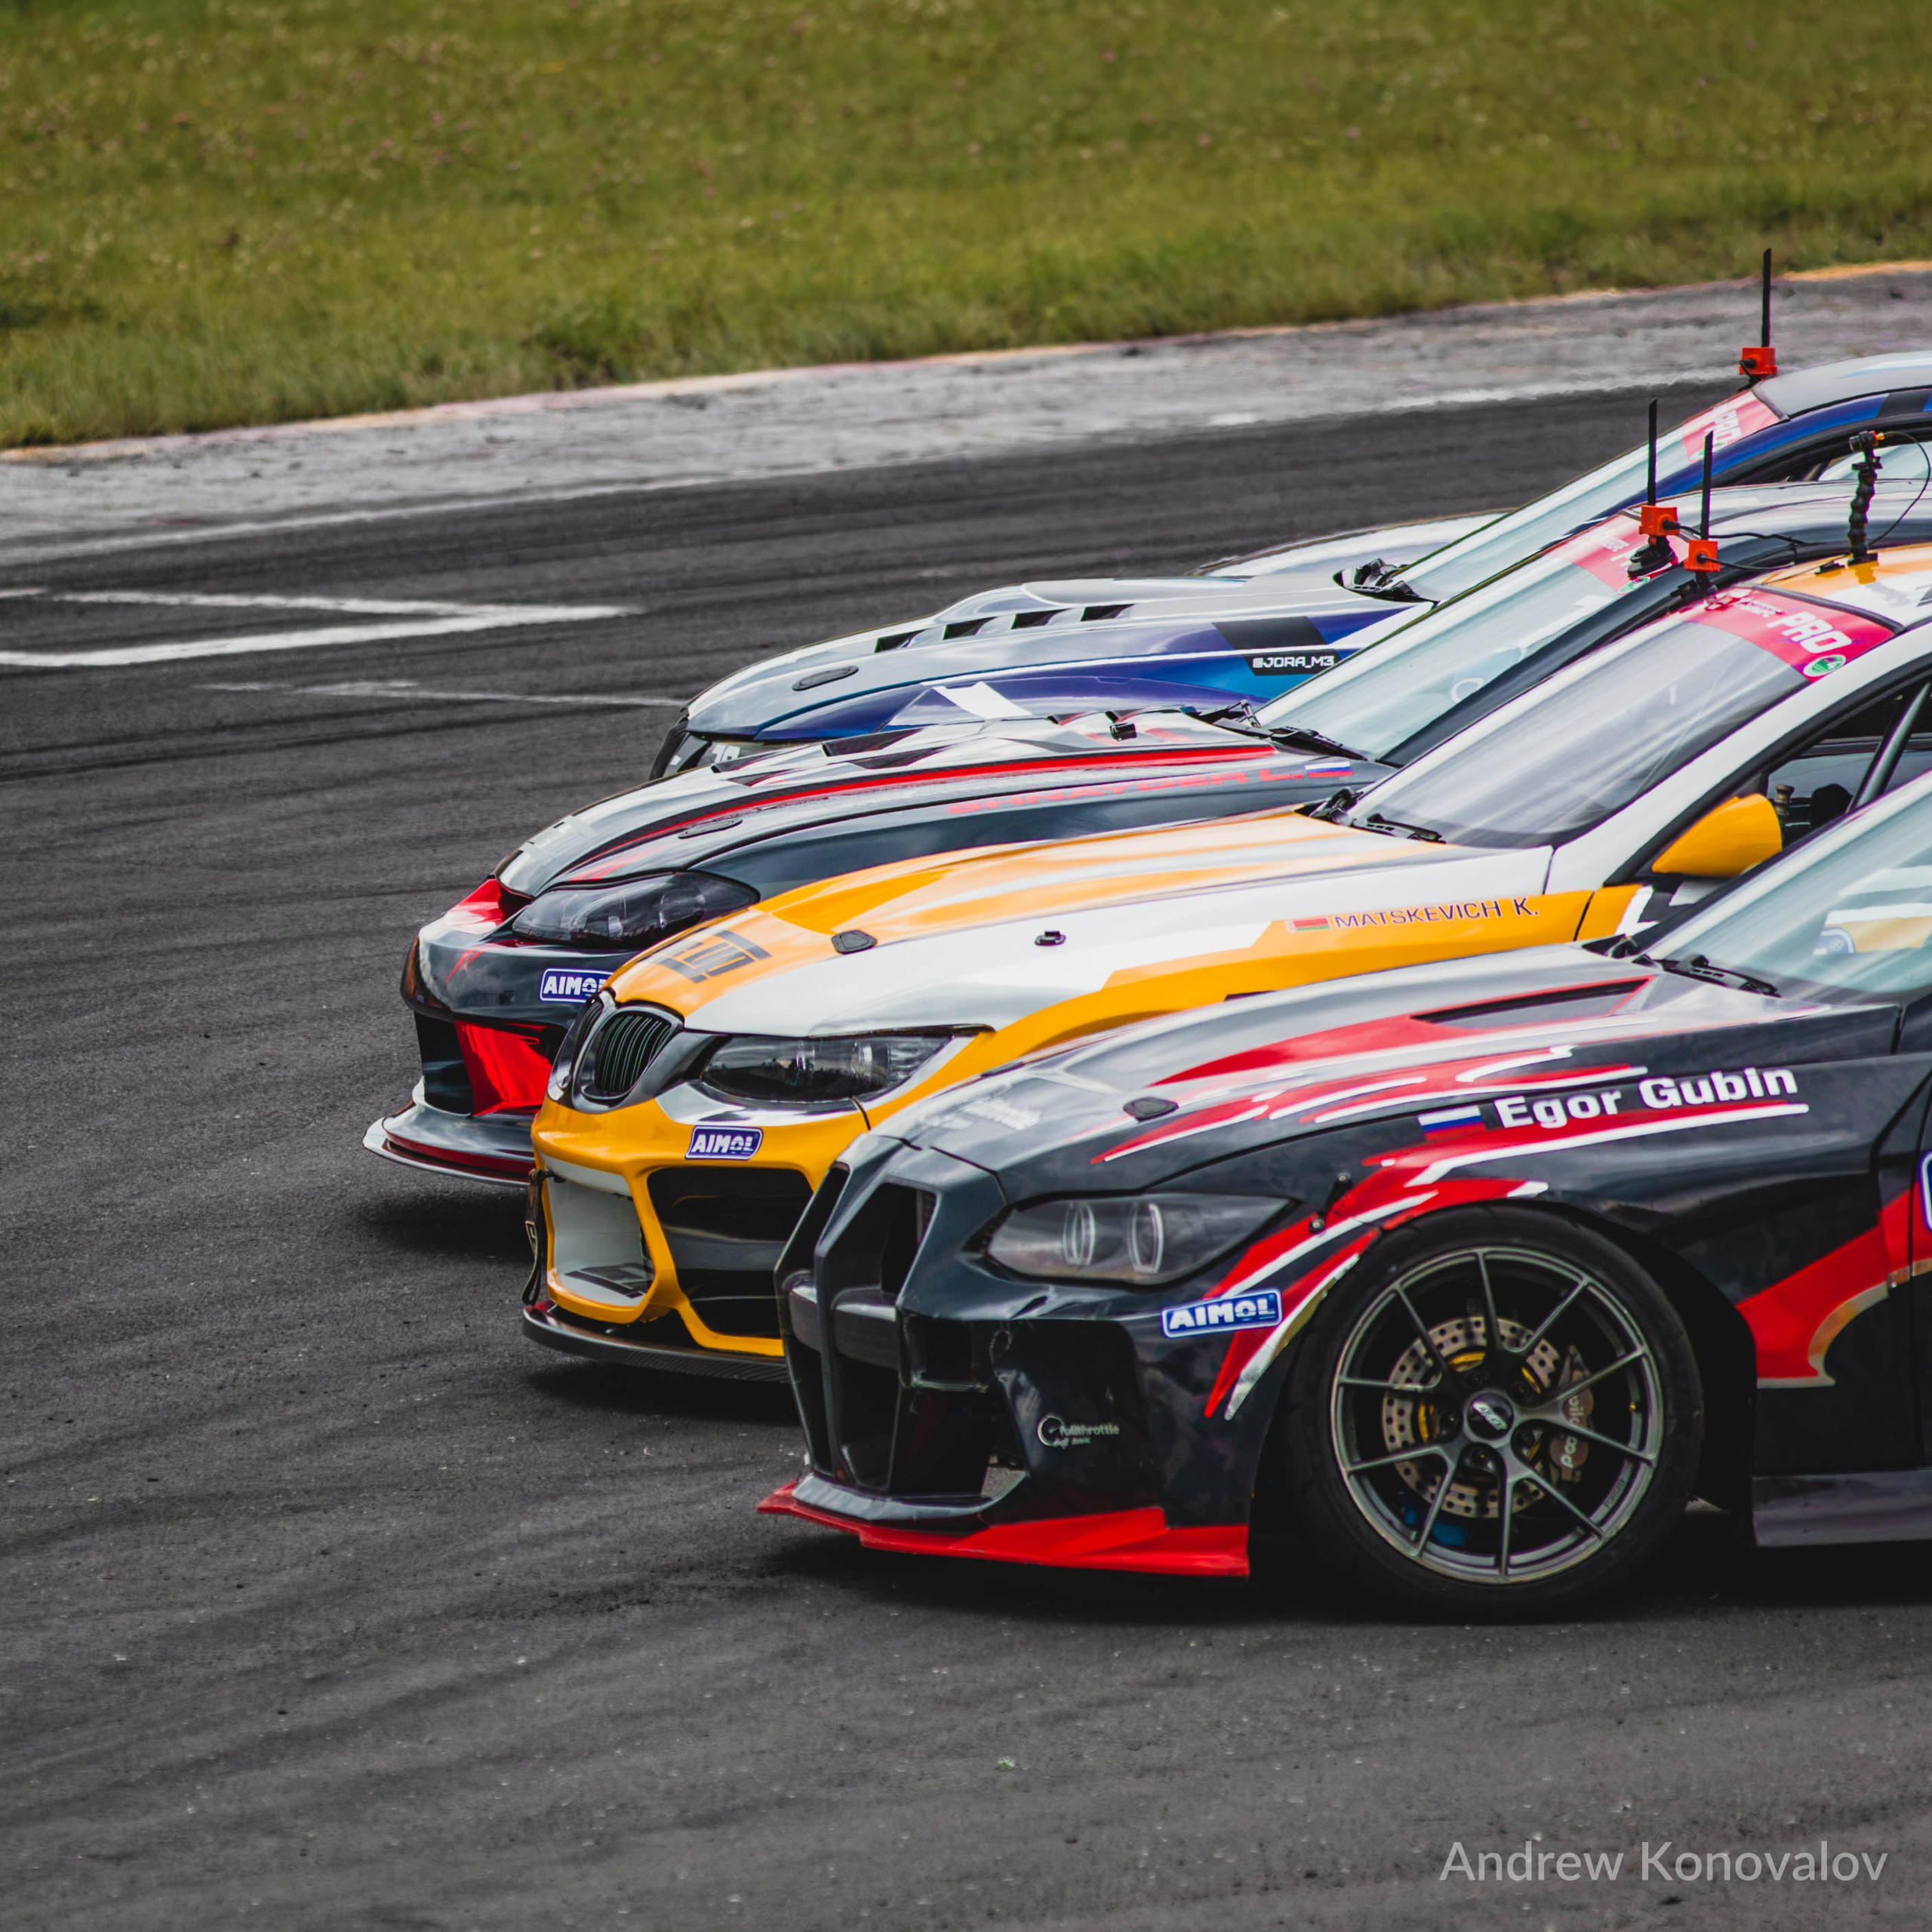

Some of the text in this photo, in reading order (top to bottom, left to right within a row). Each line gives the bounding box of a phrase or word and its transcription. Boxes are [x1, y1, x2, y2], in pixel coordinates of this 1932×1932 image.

[1766, 611, 1852, 654] PRO
[1253, 656, 1334, 668] @JORA_M3
[1334, 897, 1539, 928] MATSKEVICH K.
[1494, 1068, 1798, 1128] Egor Gubin
[691, 1134, 753, 1153] AIMOL
[1170, 1298, 1275, 1330] AIMOL
